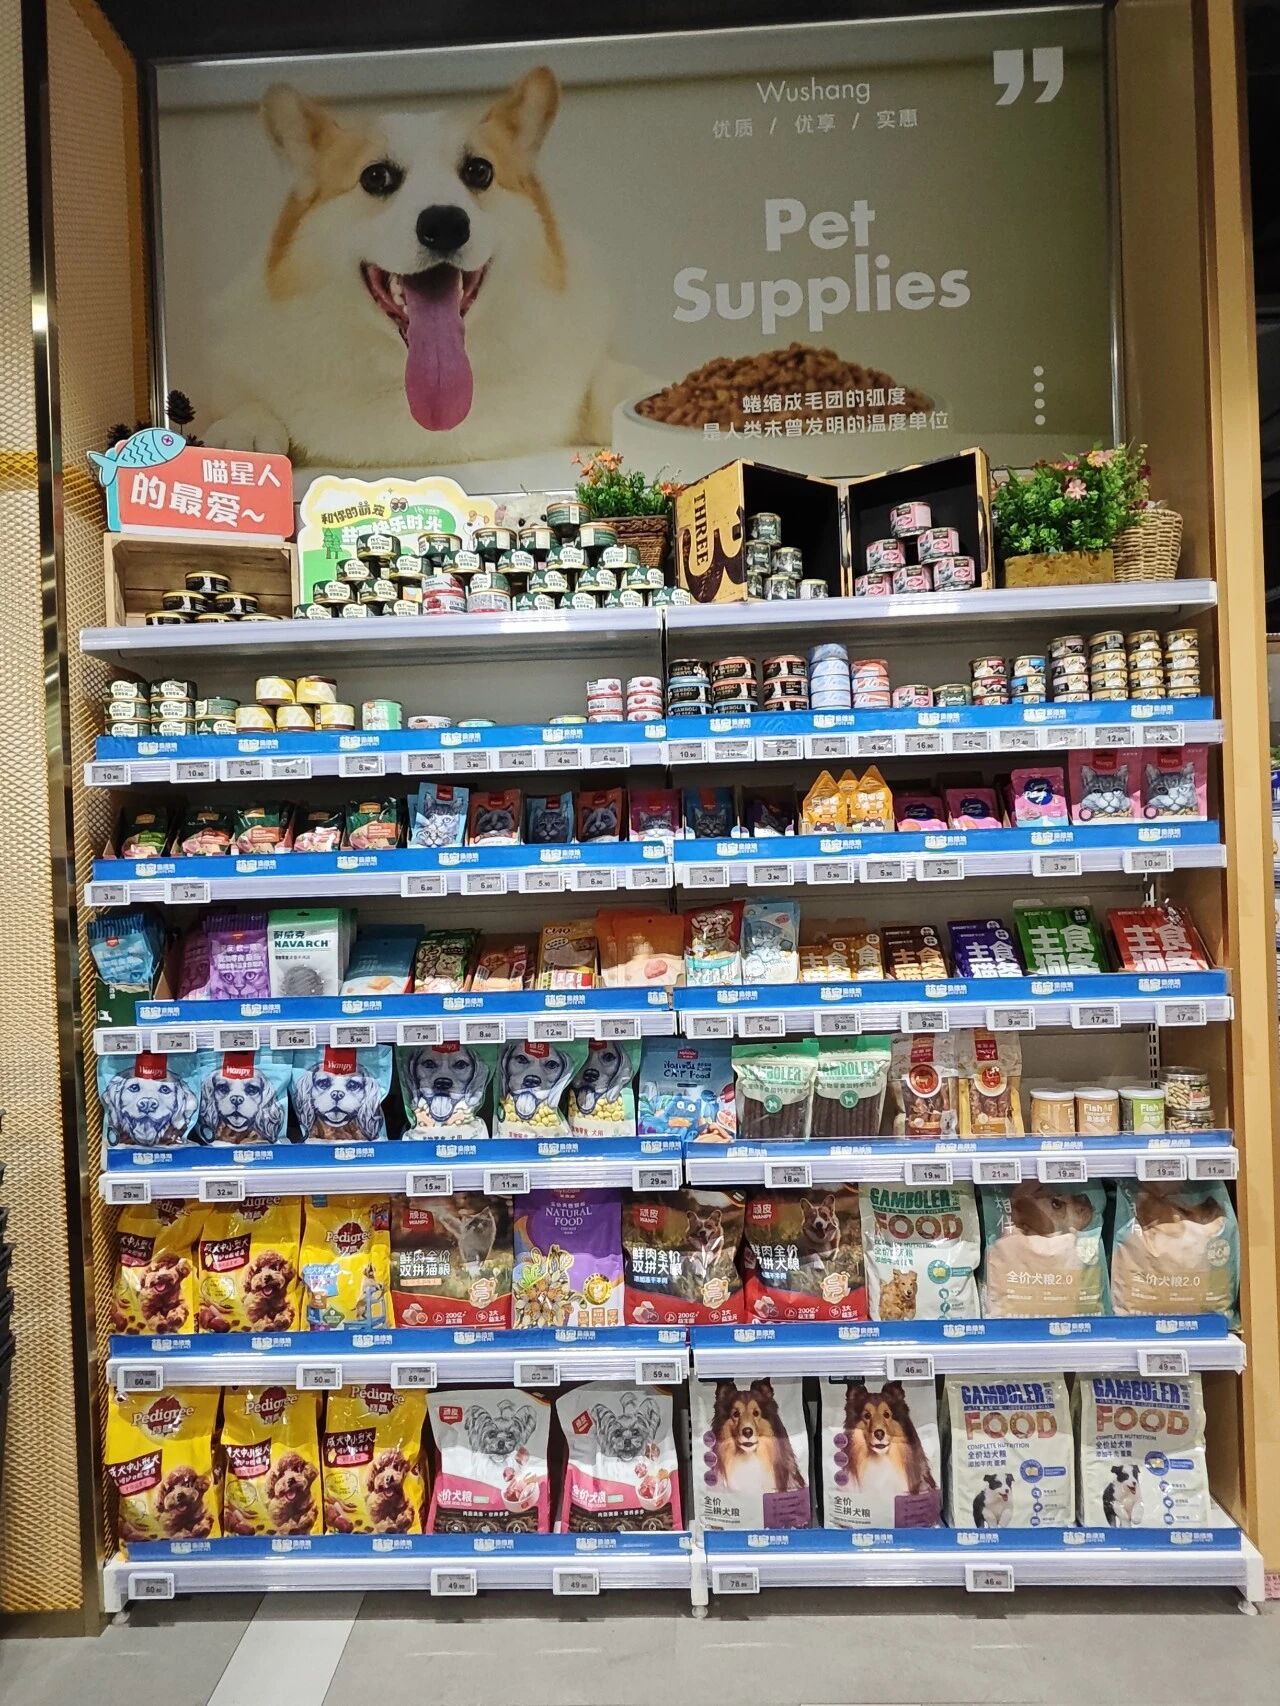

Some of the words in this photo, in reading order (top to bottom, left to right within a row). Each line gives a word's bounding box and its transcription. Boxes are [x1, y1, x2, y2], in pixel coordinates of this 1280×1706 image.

[756, 77, 870, 104] Wushang
[712, 118, 753, 138] 优质
[795, 113, 836, 134] 优享
[876, 109, 918, 129] 实惠
[765, 199, 875, 251] Pet
[673, 254, 970, 334] Supplies
[742, 387, 906, 413] 蜷缩成毛团的弧度
[703, 411, 949, 441] 是人类未曾发明的温度单位
[202, 459, 281, 488] 喵星人
[694, 490, 709, 566] THREE
[1029, 925, 1094, 952] 主食
[1123, 924, 1192, 951] 主食
[965, 941, 1017, 962] 主食
[226, 1067, 251, 1077] Wanpy
[327, 1061, 353, 1071] Wanpy
[870, 1188, 950, 1208] GAMBOLER
[545, 1207, 592, 1217] NATURAL
[555, 1217, 583, 1226] FOOD
[873, 1211, 963, 1240] FOOD
[400, 1249, 451, 1263] 鲜肉全价
[632, 1247, 681, 1262] 鲜肉全价
[400, 1263, 450, 1276] 双拼猫粮
[351, 1386, 405, 1405] Pedigree
[961, 1383, 1044, 1405] GAMBOLER
[1093, 1378, 1180, 1403] GAMBOLER
[245, 1394, 297, 1415] Pedigree
[132, 1405, 194, 1426] Pedigree
[965, 1411, 1058, 1440] FOOD
[1096, 1405, 1189, 1435] FOOD
[704, 1496, 721, 1506] 全价
[704, 1506, 740, 1517] 三拼犬粮
[834, 1496, 852, 1506] 全价
[834, 1506, 870, 1517] 三拼犬粮
